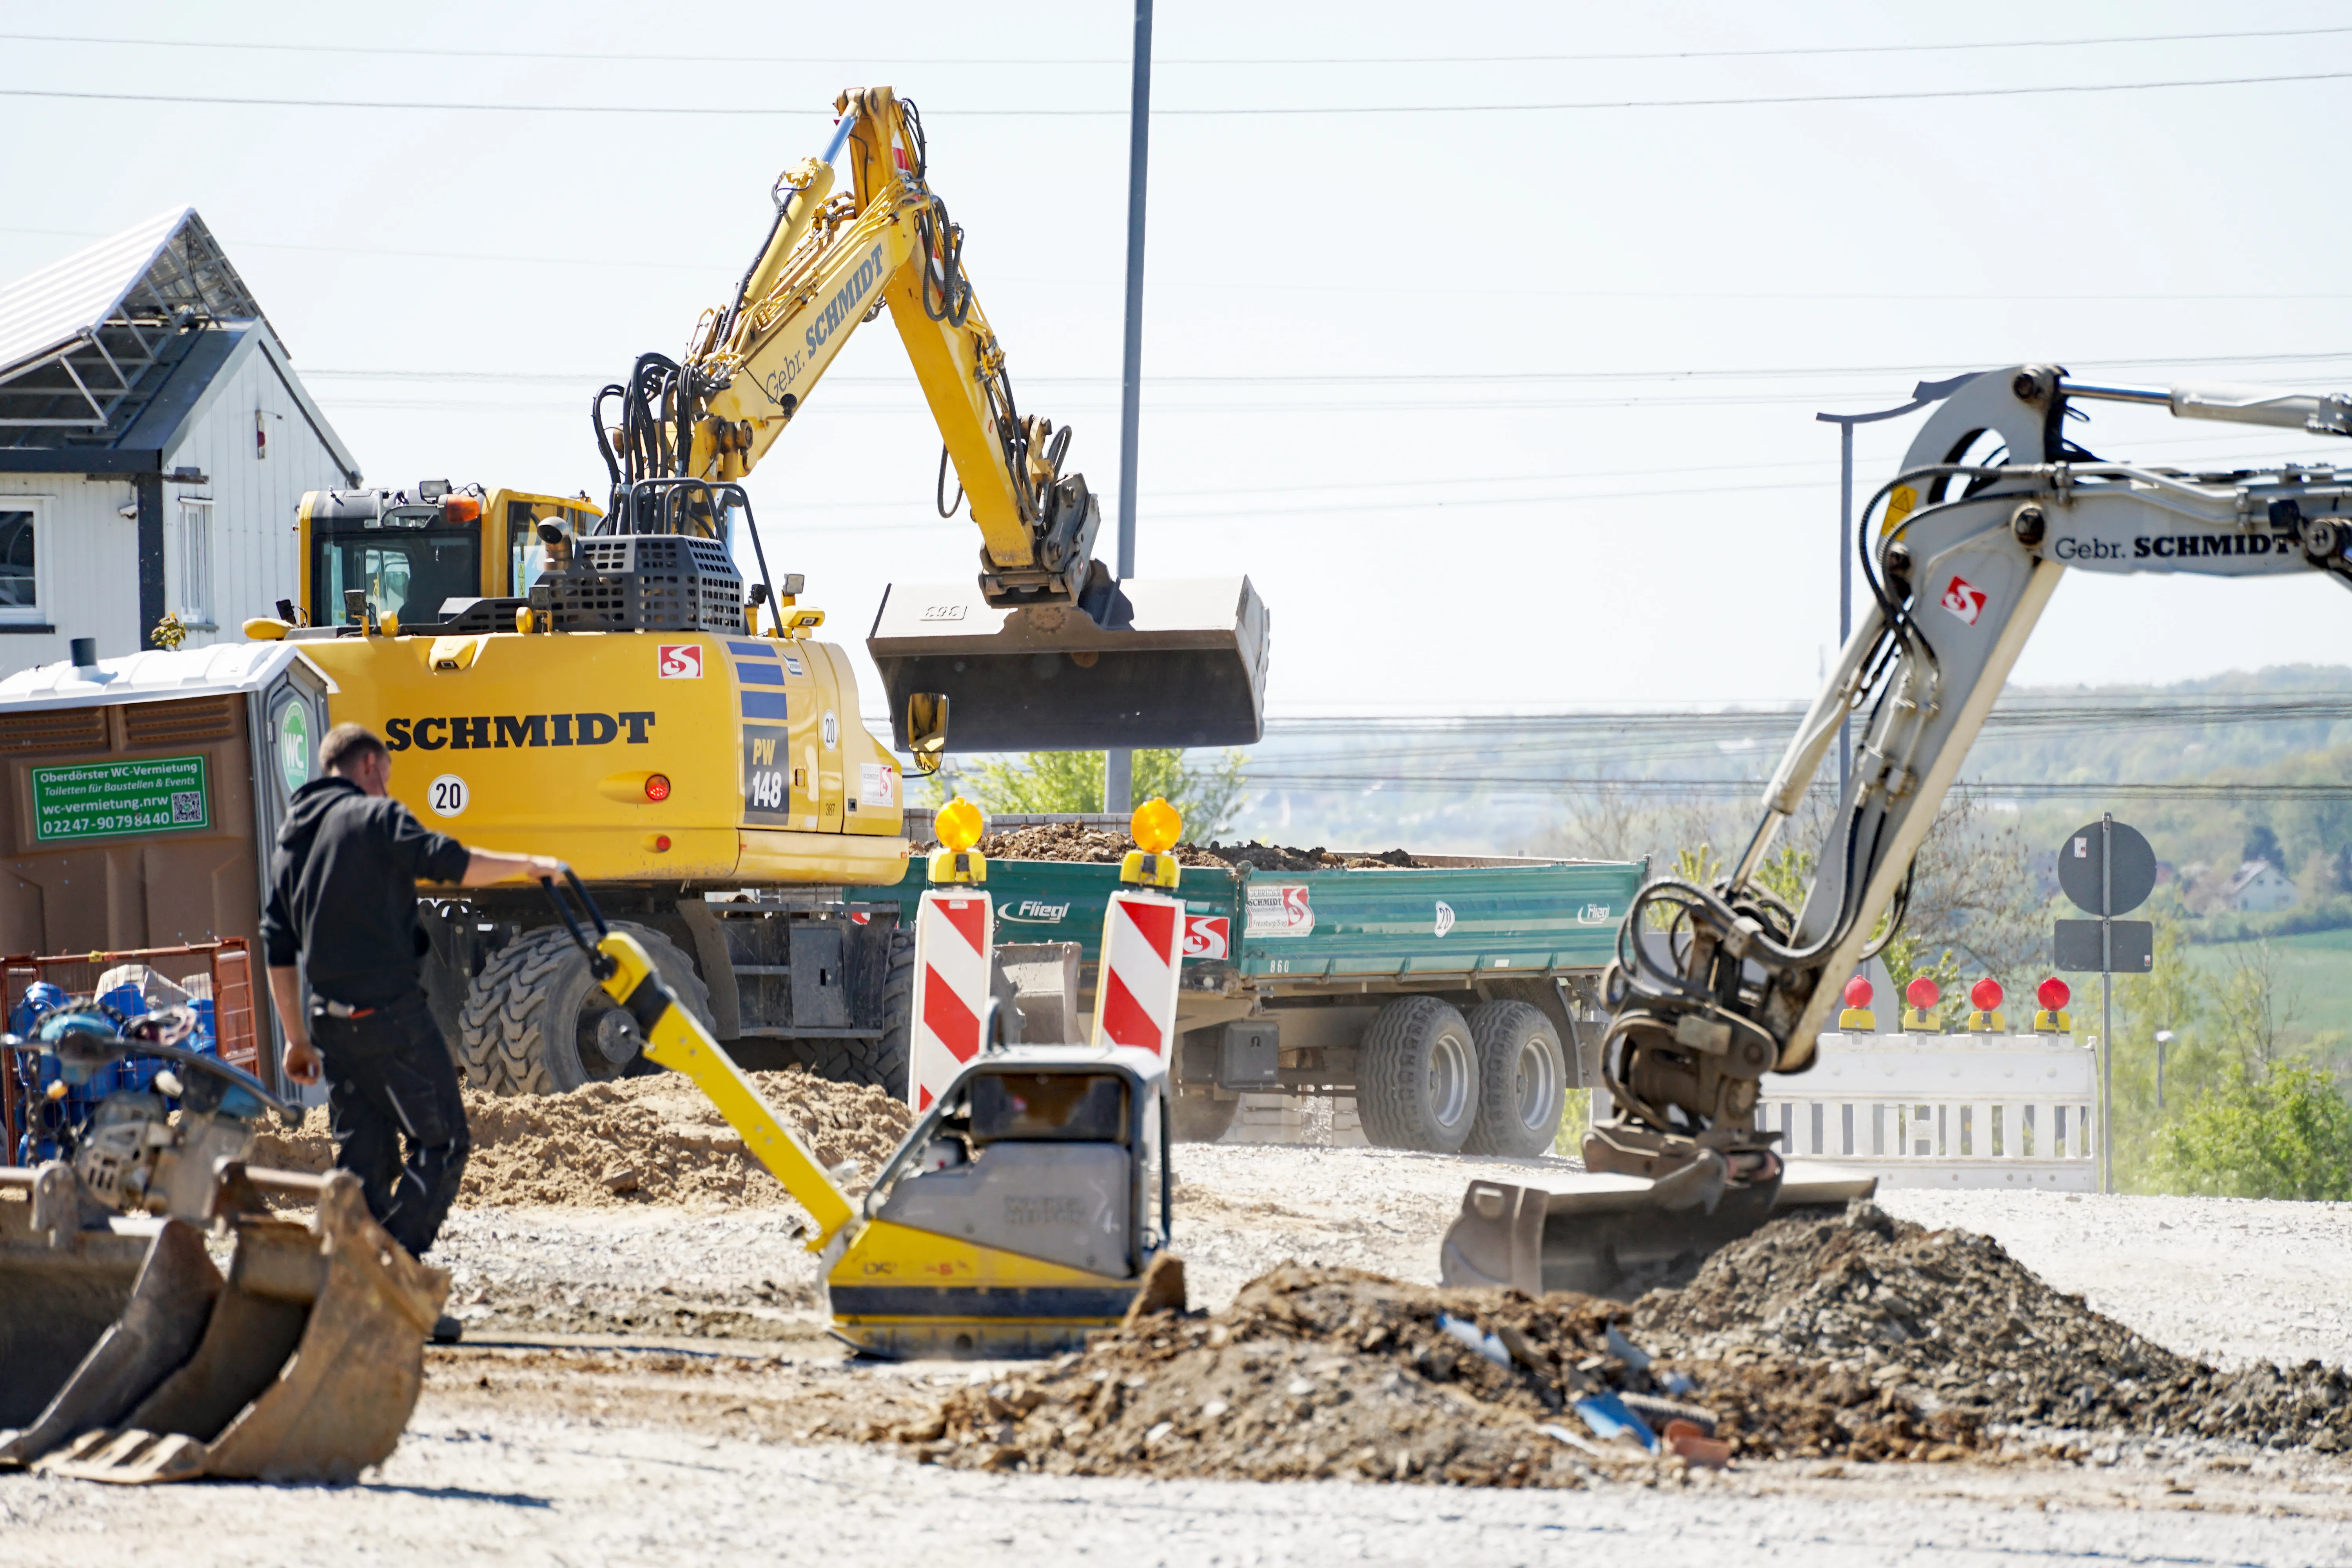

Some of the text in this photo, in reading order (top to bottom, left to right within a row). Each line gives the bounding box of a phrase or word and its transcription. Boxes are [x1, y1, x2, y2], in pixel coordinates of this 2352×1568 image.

[766, 242, 883, 404] Gebr. SCHMIDT
[2055, 537, 2126, 560] Gebr.
[385, 711, 655, 752] SCHMIDT
[825, 718, 835, 743] 20
[285, 732, 305, 769] WC
[753, 738, 776, 766] PW
[40, 763, 198, 783] Oberdörster WC-Vermietung
[45, 777, 195, 797] Toiletten für Baustellen & Events
[436, 783, 461, 809] 20
[752, 771, 782, 808] 148
[42, 795, 169, 815] wc-vermietung.nrw
[826, 803, 835, 817] 387
[1018, 900, 1071, 921] Fliegl
[1249, 898, 1282, 907] SCHMIDT
[1586, 903, 1610, 922] Fliegl
[1437, 907, 1451, 930] 20
[1270, 959, 1289, 973] 860
